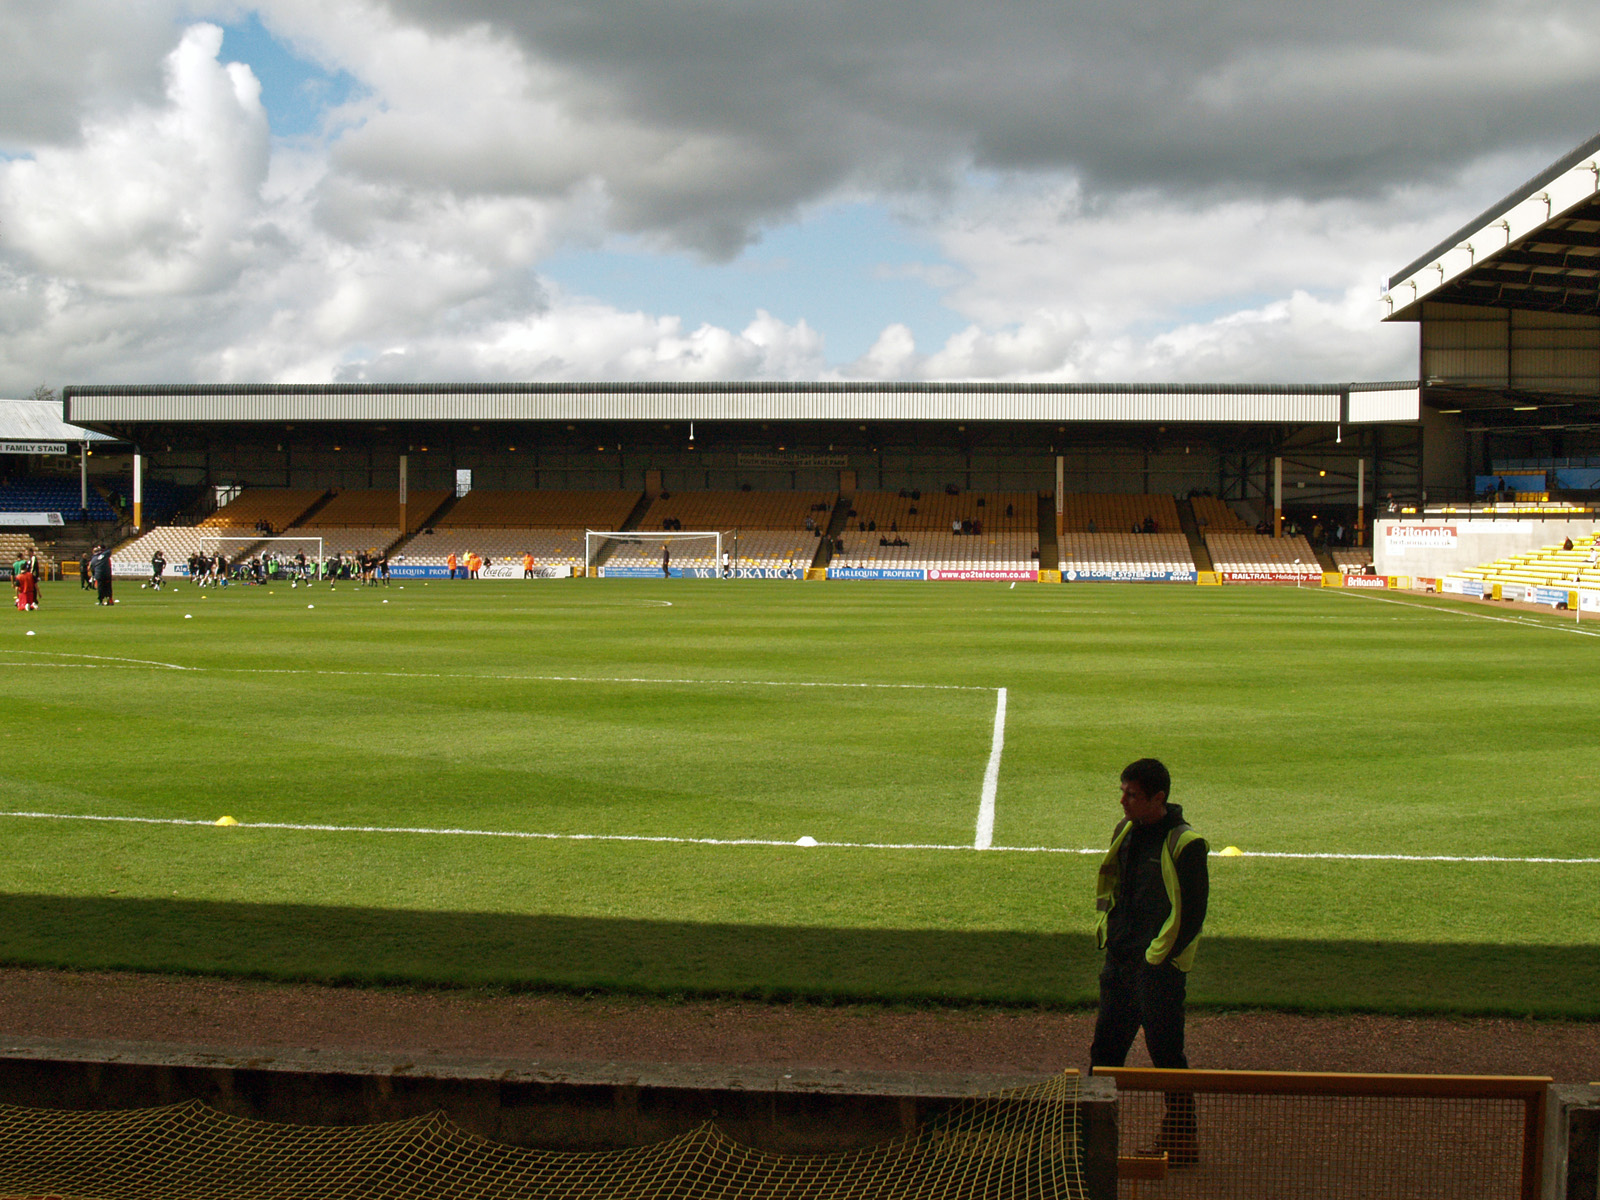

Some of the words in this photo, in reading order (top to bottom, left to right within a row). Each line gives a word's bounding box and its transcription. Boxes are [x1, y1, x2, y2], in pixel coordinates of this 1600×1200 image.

[5, 444, 35, 452] FAMILY
[1391, 527, 1452, 537] Britannia
[388, 568, 425, 576] ARLEQUIN
[694, 568, 709, 578] VK
[831, 569, 879, 578] HARLEQUIN
[882, 570, 920, 578] PROPERTY
[941, 571, 1031, 579] www.go2telecom.co.uk
[1347, 576, 1385, 587] Britannia
